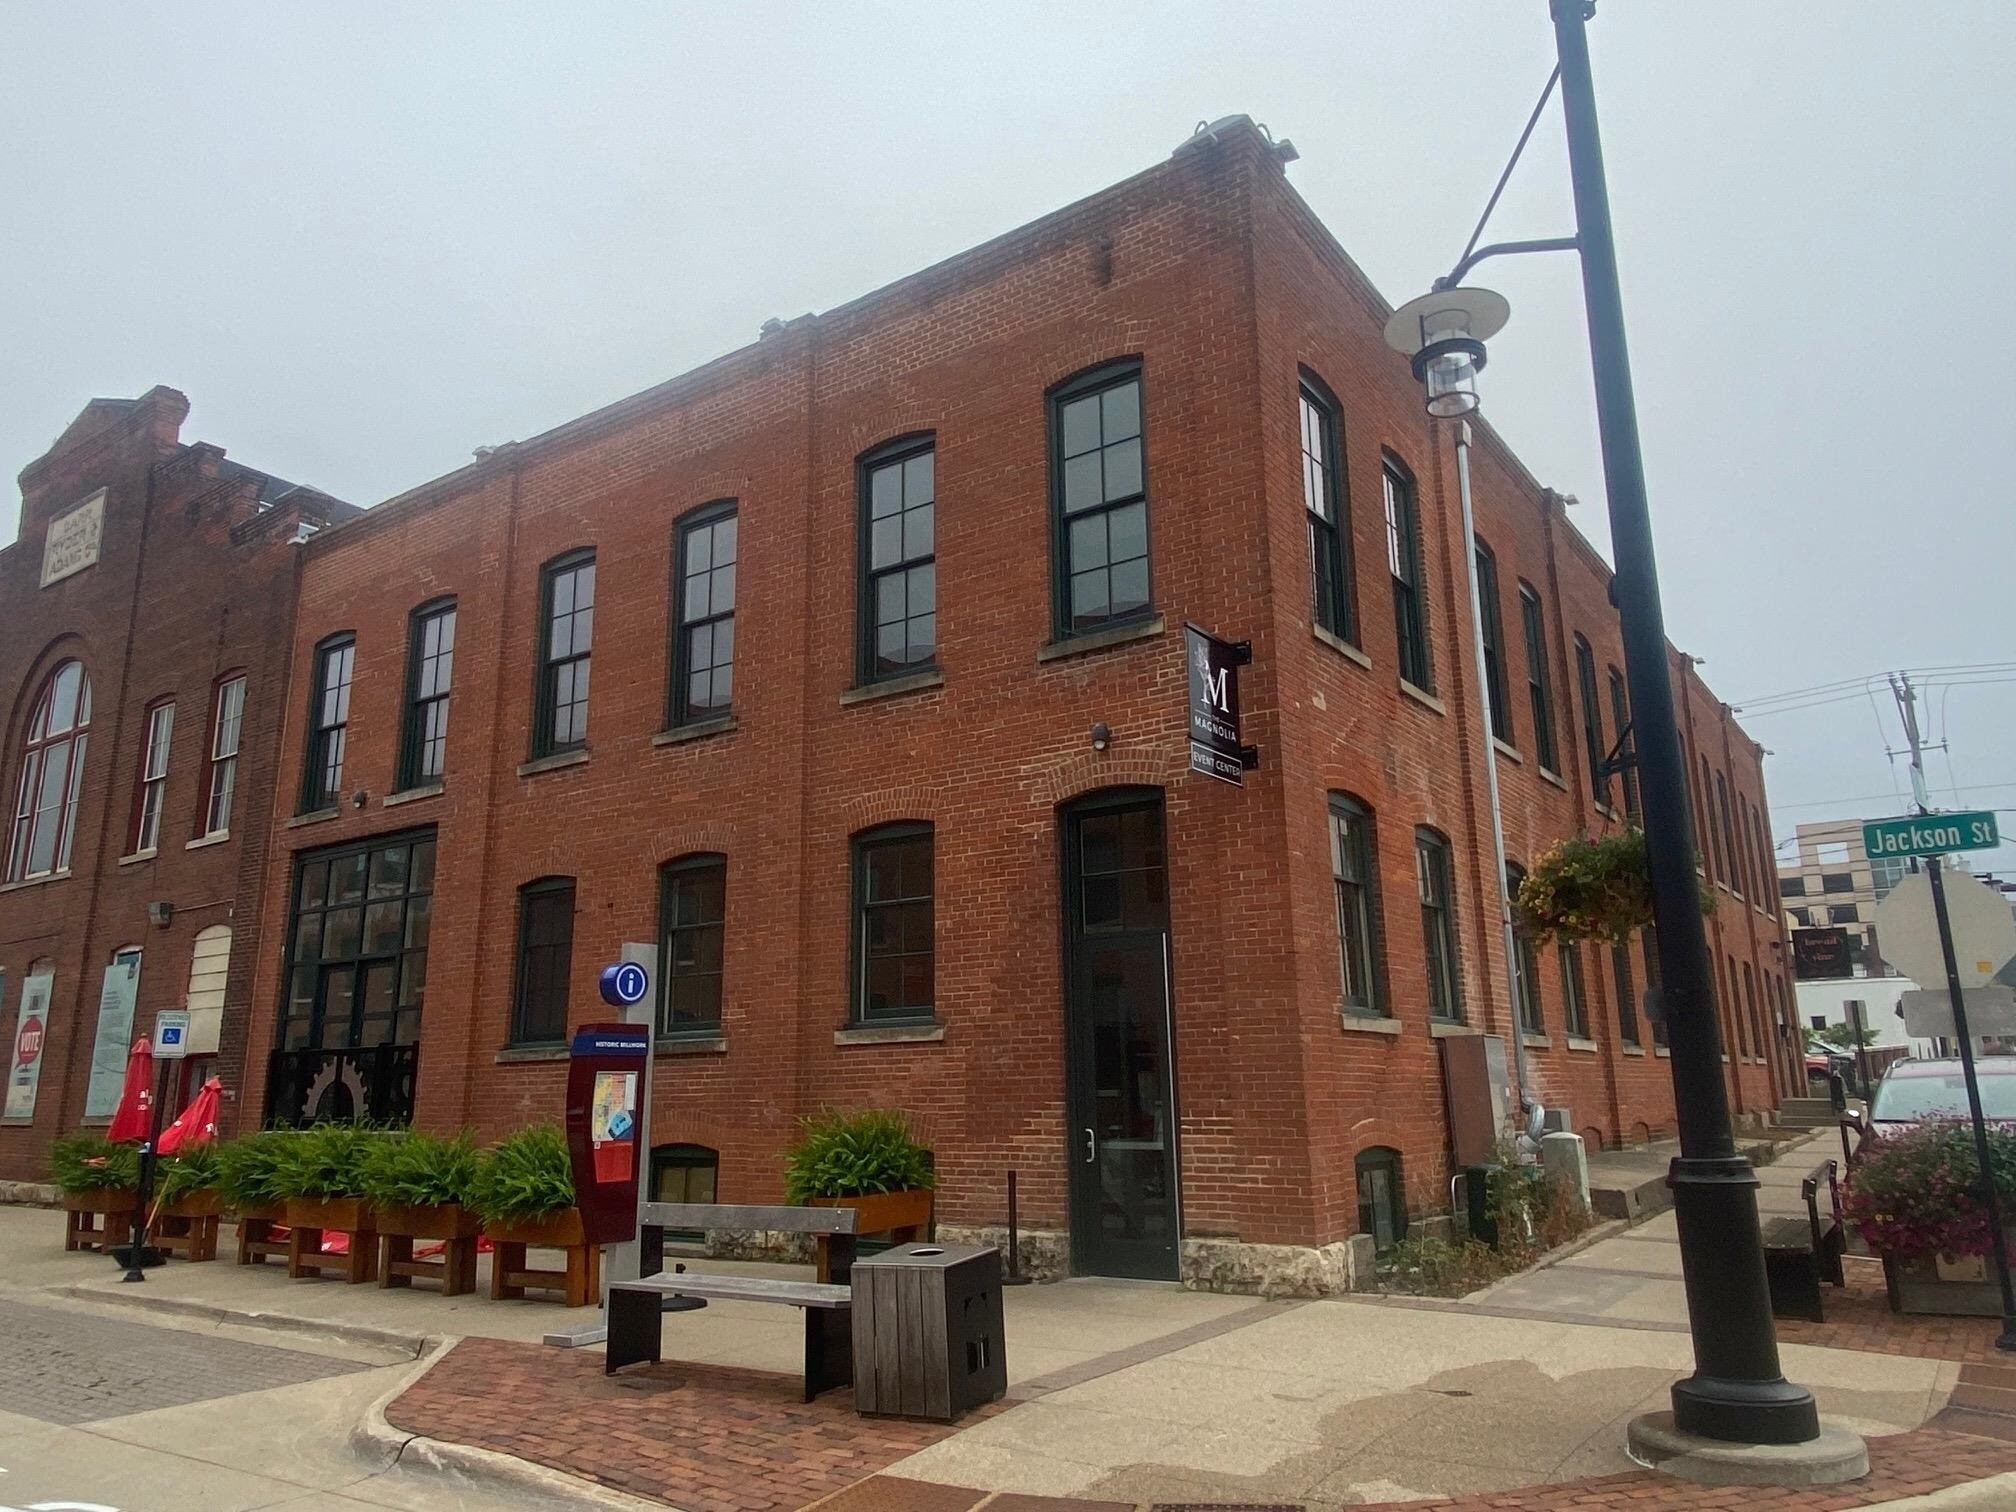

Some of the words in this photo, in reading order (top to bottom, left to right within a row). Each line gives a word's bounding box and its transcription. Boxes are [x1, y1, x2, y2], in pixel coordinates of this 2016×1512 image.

[1200, 660, 1230, 713] M
[1194, 715, 1237, 743] MAGNOLIA
[1193, 750, 1215, 768] EVENT
[1215, 760, 1240, 777] CENTER
[1872, 825, 1961, 853] Jackson
[1971, 821, 1993, 844] St
[20, 1030, 41, 1053] VOTE
